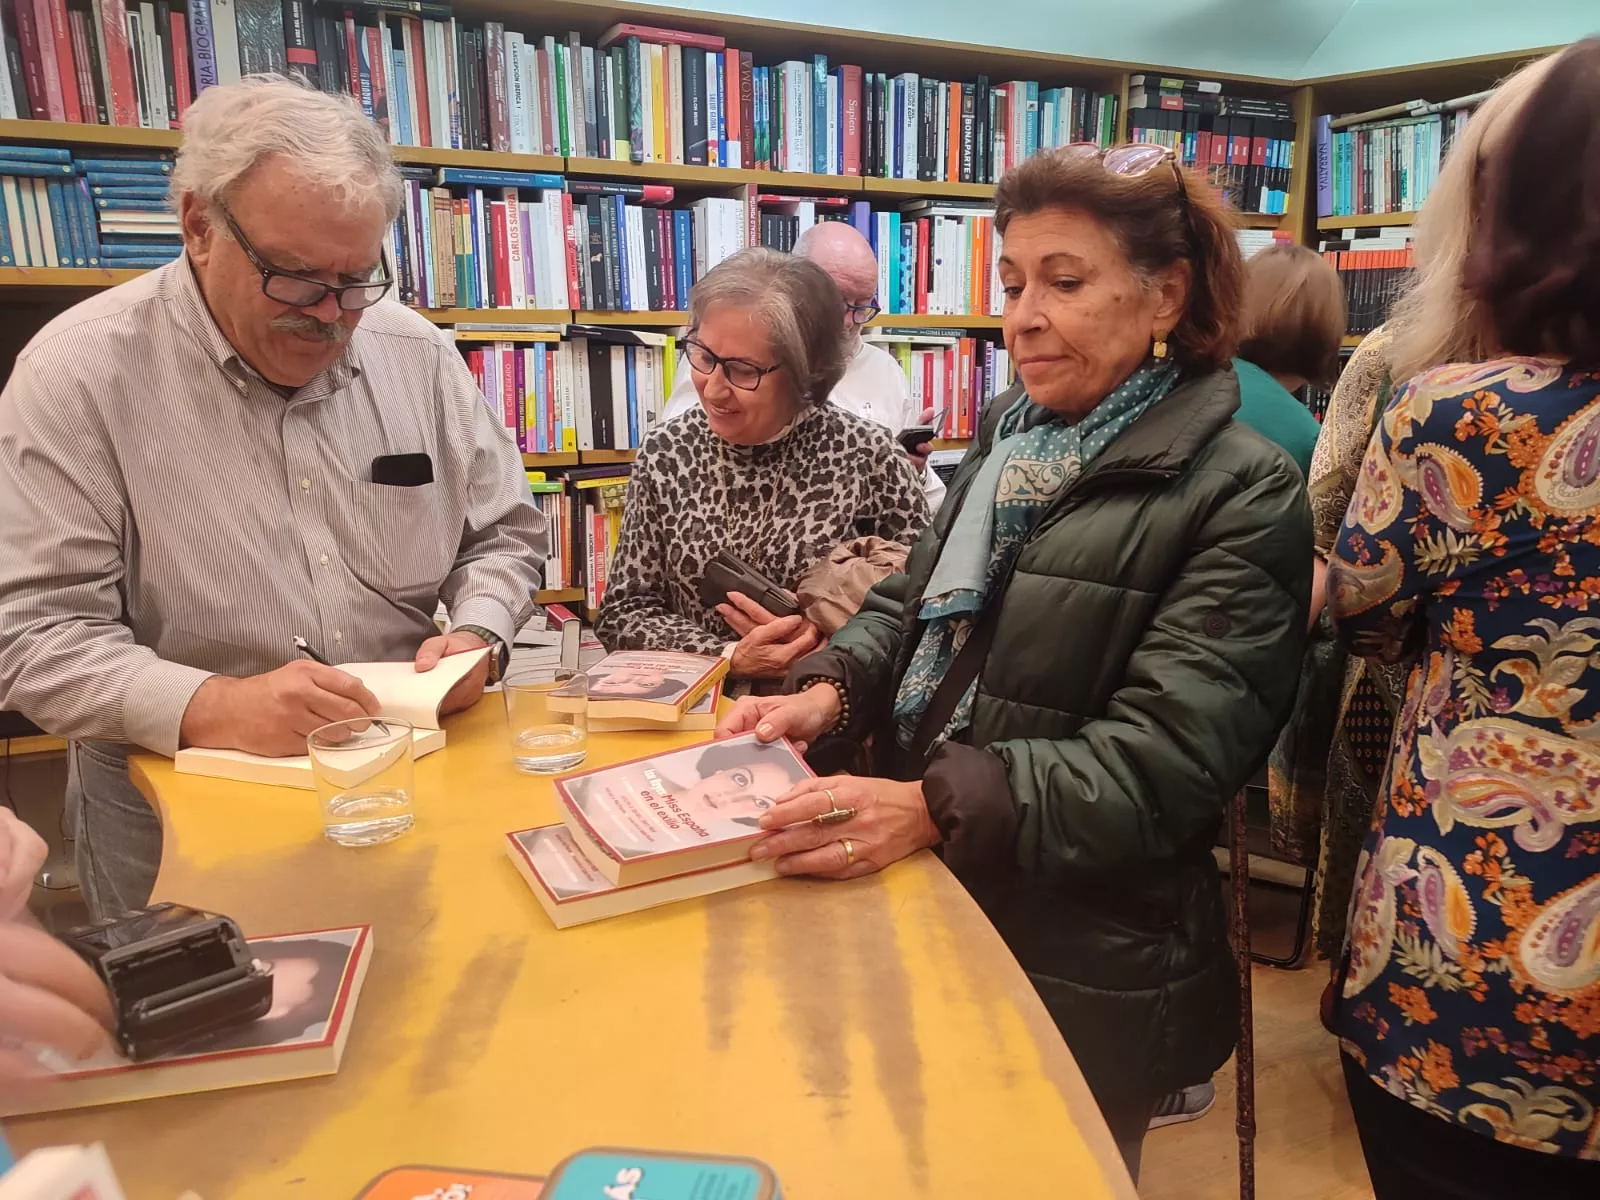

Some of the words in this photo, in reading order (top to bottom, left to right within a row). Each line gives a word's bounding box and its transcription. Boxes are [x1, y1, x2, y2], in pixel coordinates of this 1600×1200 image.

[193, 0, 214, 89] RIA-BIOGRAF
[741, 60, 751, 102] ROMA
[846, 99, 857, 136] Sapiens
[963, 118, 973, 174] BONAPARTE
[1319, 143, 1329, 191] NARRATIVA
[507, 193, 517, 225] SAURA
[510, 226, 520, 261] CARLOS
[640, 790, 652, 803] en
[649, 801, 661, 813] el
[656, 810, 681, 830] exilio
[664, 793, 682, 815] Miss
[677, 812, 710, 838] España
